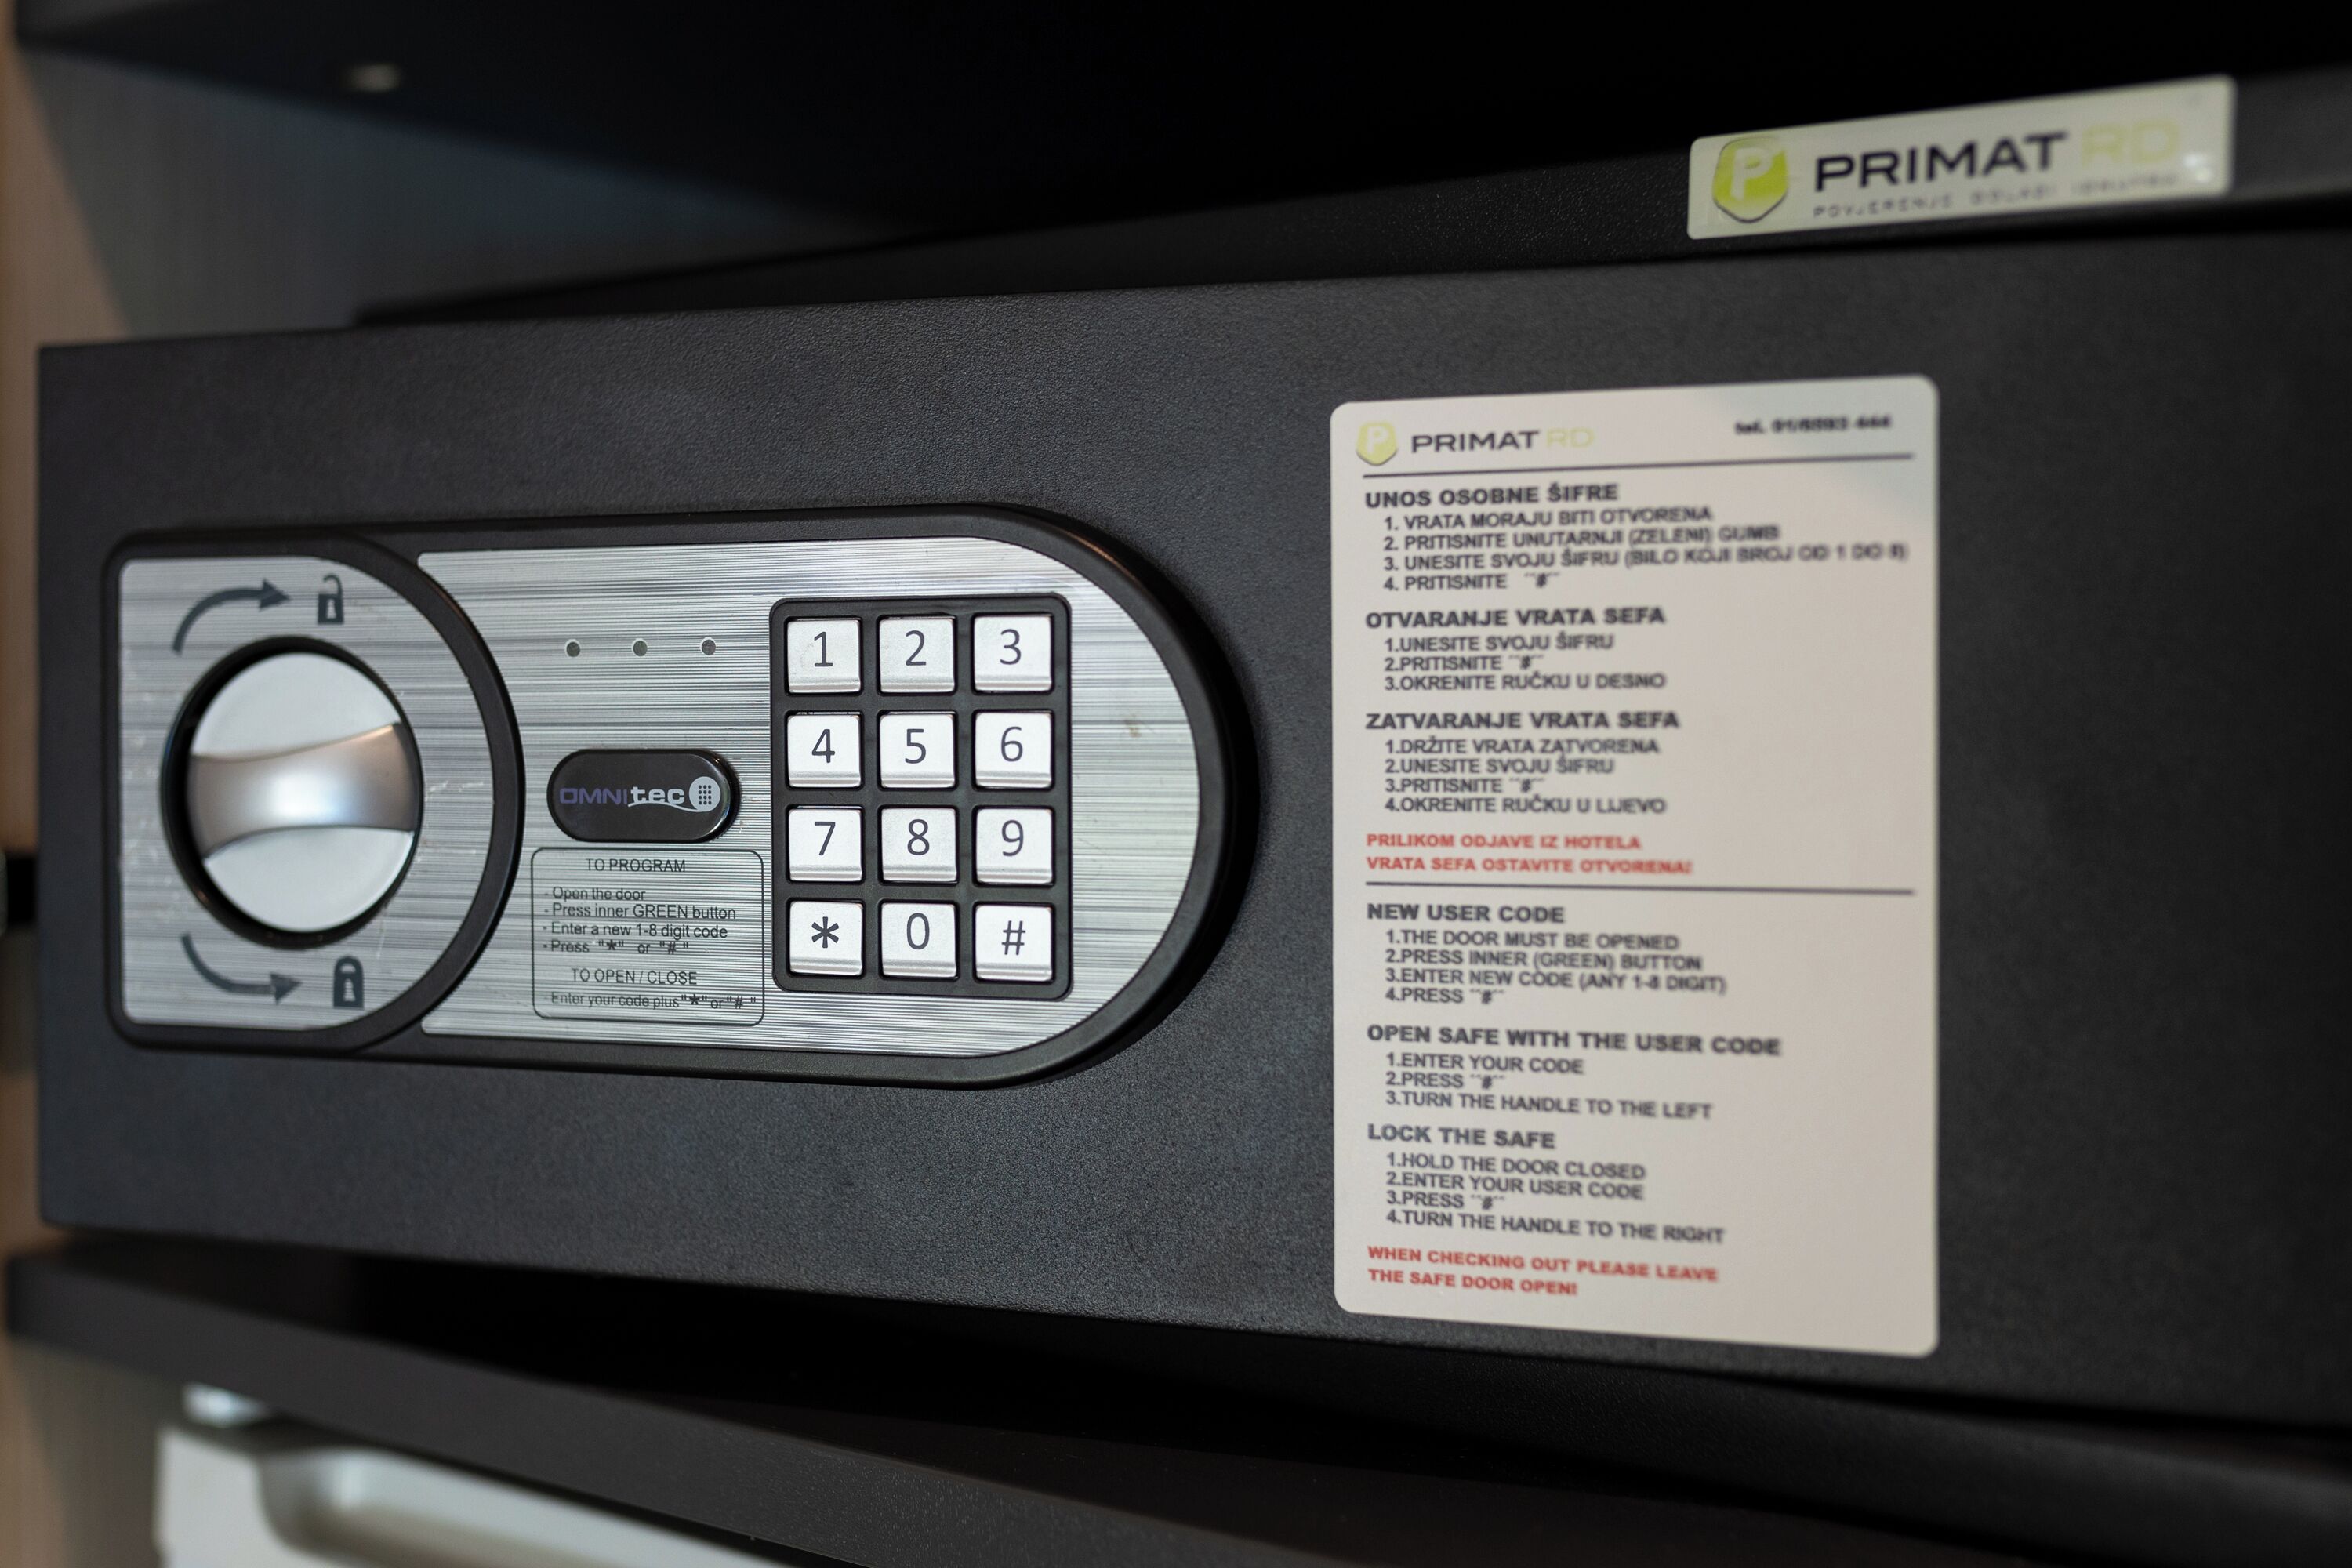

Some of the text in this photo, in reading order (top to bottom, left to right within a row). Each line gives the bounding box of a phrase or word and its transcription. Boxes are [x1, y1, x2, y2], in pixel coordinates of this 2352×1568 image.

[1814, 130, 2068, 193] PRIMAT
[1411, 430, 1539, 453] PRIMAT
[1366, 481, 1618, 508] UNOS OSOBNE ŠIFRE
[1385, 506, 1711, 530] 1. VRATA MORAJU BITI OTVORENA
[1384, 527, 1712, 550] 2. PRITISNITE UNUTARNJI (ZELENI)
[1384, 548, 1618, 571] 3. UNESITE SVOJU ŠIFRU
[1384, 575, 1506, 590] 4. PRITISNITE
[1366, 607, 1665, 628] OTVARANJE VRATA SEFA
[814, 629, 1022, 667] 1 2 3
[1385, 633, 1614, 652] 1.UNESITE SVOJU ŠIFRU
[1385, 656, 1501, 672] 2.PRITISNITE
[1385, 672, 1666, 691] 3.OKRENITE RUČKU DESNO
[1366, 712, 1679, 730] ZATVARANJE VRATA SEFA
[811, 727, 1023, 764] 4 5 6
[1385, 737, 1659, 754] 1.DRŽITE VRATA ZATVORENA
[1385, 756, 1614, 774] 2.UNESITE SVOJU ŠIFRU
[1385, 779, 1502, 793] 3.PRITISNITE
[1385, 794, 1666, 813] 4.OKRENITE RUČKU LIJEVO
[814, 819, 1024, 857] 7 8 9
[1367, 834, 1641, 849] PRILIKOM ODJAVE IZ HOTELA
[587, 858, 685, 872] TO PROGRAM
[1367, 858, 1573, 873] VRATA SEFA OSTAVITE
[553, 887, 645, 901] Open the door
[554, 905, 735, 919] Press inner GREEN button
[1367, 903, 1565, 924] NEW USER CODE
[552, 922, 728, 940] Enter a new 1-8 digit code
[906, 913, 930, 950] 0
[1002, 920, 1025, 956] #
[1386, 930, 1679, 950] 1.THE DOOR MUST BE OPENED
[551, 940, 650, 953] Press or
[1386, 949, 1701, 971] 2.PRESS INNER (GREEN) BUTTON
[572, 968, 698, 985] TO OPEN CLOSE
[1386, 969, 1726, 995] 3.ENTER NEW CODE (ANY 1-8 DIGIT)
[551, 993, 584, 1004] Enter
[588, 994, 614, 1007] your
[619, 994, 651, 1007] code
[1386, 988, 1463, 1004] 4.PRESS
[1367, 1025, 1780, 1056] OPEN SAFE WITH THE USER CODE
[1386, 1053, 1583, 1074] 1.ENTER YOUR CODE
[1386, 1073, 1463, 1088] 2.PRESS
[1386, 1091, 1711, 1119] 3.TURN THE HANDLE TO THE LEFT
[1368, 1124, 1555, 1149] LOCK THE SAFE
[1386, 1153, 1645, 1178] 1.HOLD THE DOOR CLOSED
[1386, 1172, 1643, 1200] 2.ENTER YOUR USER CODE
[1386, 1191, 1464, 1207] 3.PRESS
[1386, 1210, 1723, 1243] 4.TURN THE HANDLE TO THE RIGHT
[1368, 1246, 1718, 1281] WHEN CHECKING OUT PLEASE LEAVE
[1369, 1269, 1577, 1295] THE SAFE DOOR OPEN!
